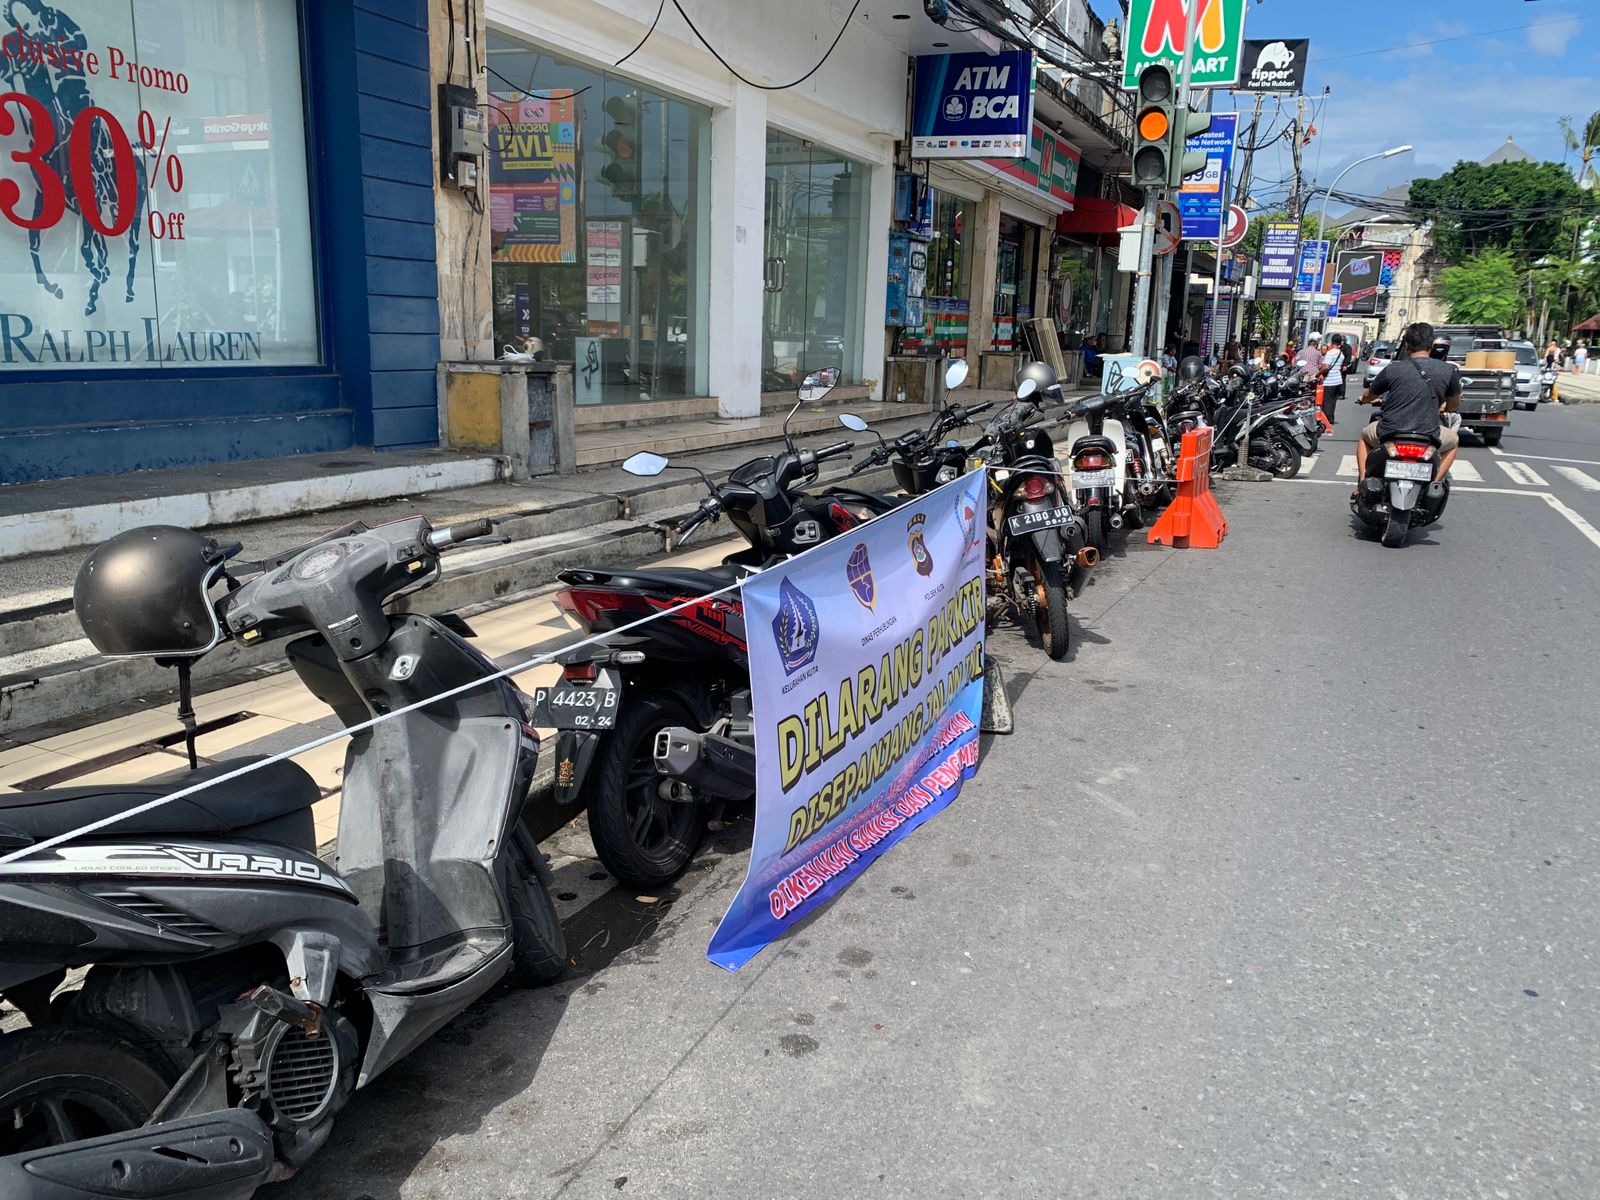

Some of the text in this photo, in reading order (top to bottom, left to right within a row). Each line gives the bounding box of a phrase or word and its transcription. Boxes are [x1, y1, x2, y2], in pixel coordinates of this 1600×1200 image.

[106, 46, 188, 94] Promo
[953, 65, 1010, 91] ATM
[1251, 67, 1290, 81] fipper
[969, 95, 1019, 119] BCA
[1201, 138, 1232, 146] Network
[1206, 170, 1219, 178] GB
[148, 211, 185, 240] Off
[1, 313, 263, 364] RALPH LAUREN
[1011, 517, 1020, 528] K
[1024, 511, 1049, 525] 2180
[777, 576, 985, 794] DILARANG PARKIR
[536, 690, 617, 708] P 4423 B
[781, 701, 924, 859] DISEPANJANG
[161, 847, 322, 880] VARIO
[768, 835, 860, 920] DIKENAKAN
[849, 806, 906, 853] SANKSI
